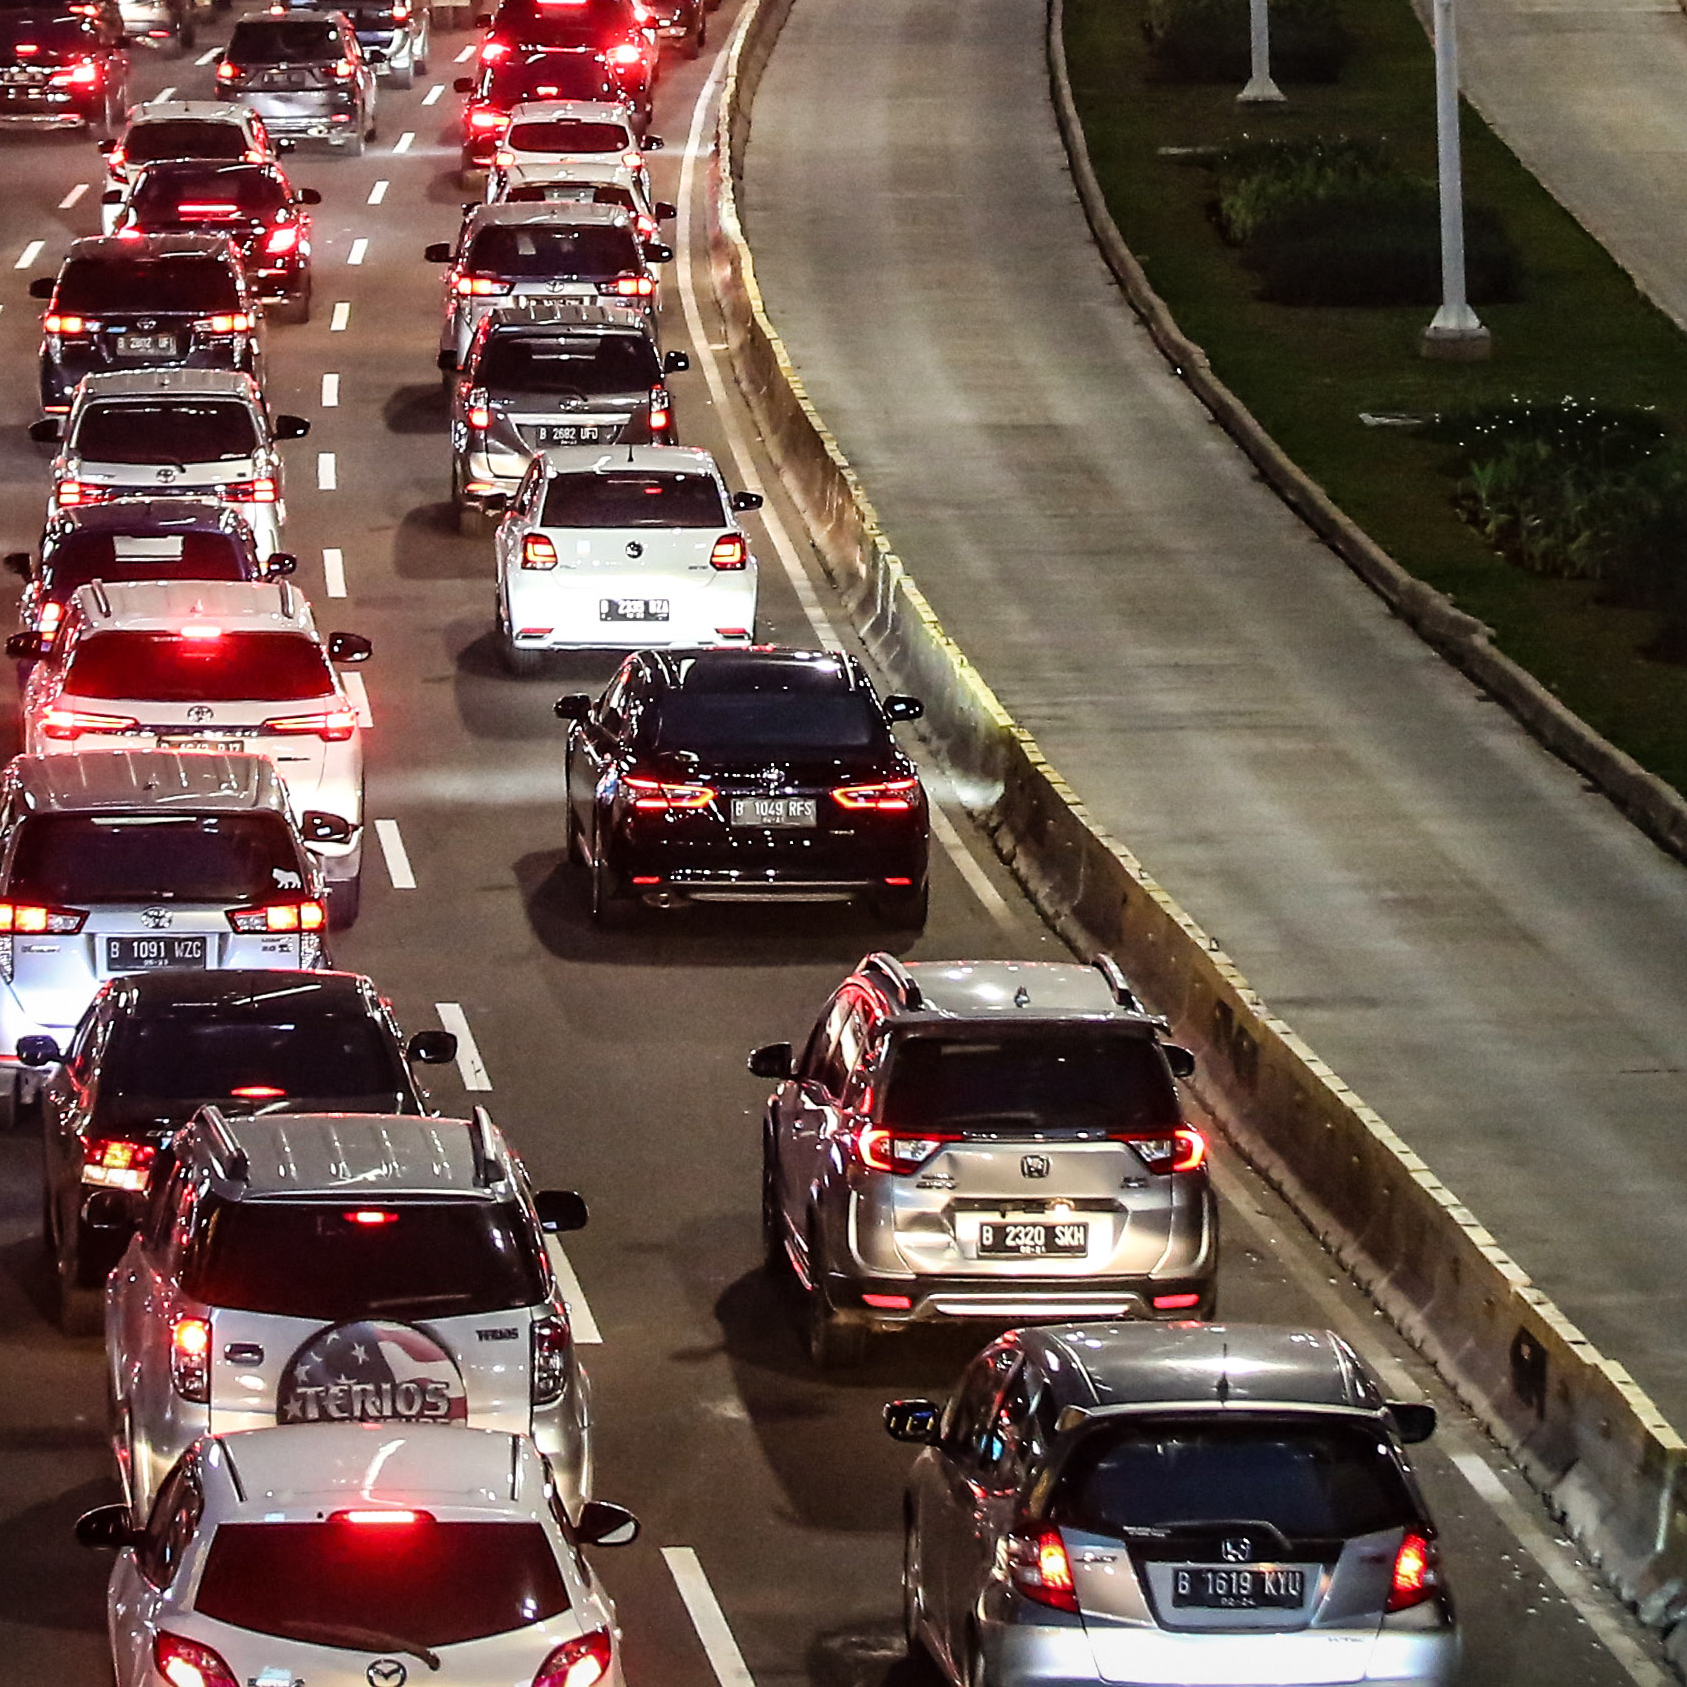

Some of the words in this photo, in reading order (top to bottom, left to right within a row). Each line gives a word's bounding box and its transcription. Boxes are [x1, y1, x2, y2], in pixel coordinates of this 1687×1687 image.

[540, 427, 547, 440] B
[735, 801, 744, 817] B
[755, 801, 784, 817] 1049
[788, 801, 813, 817] RFS
[110, 941, 119, 958] B
[132, 941, 166, 958] 1091
[174, 941, 202, 958] WZG
[982, 1226, 993, 1246] B
[1005, 1226, 1045, 1246] 2320
[1054, 1226, 1085, 1246] SKH
[475, 1327, 519, 1342] TERIOS
[297, 1380, 450, 1420] TERIOS
[1177, 1571, 1191, 1595] B
[1204, 1570, 1253, 1595] 1619
[1264, 1570, 1301, 1596] KYU
